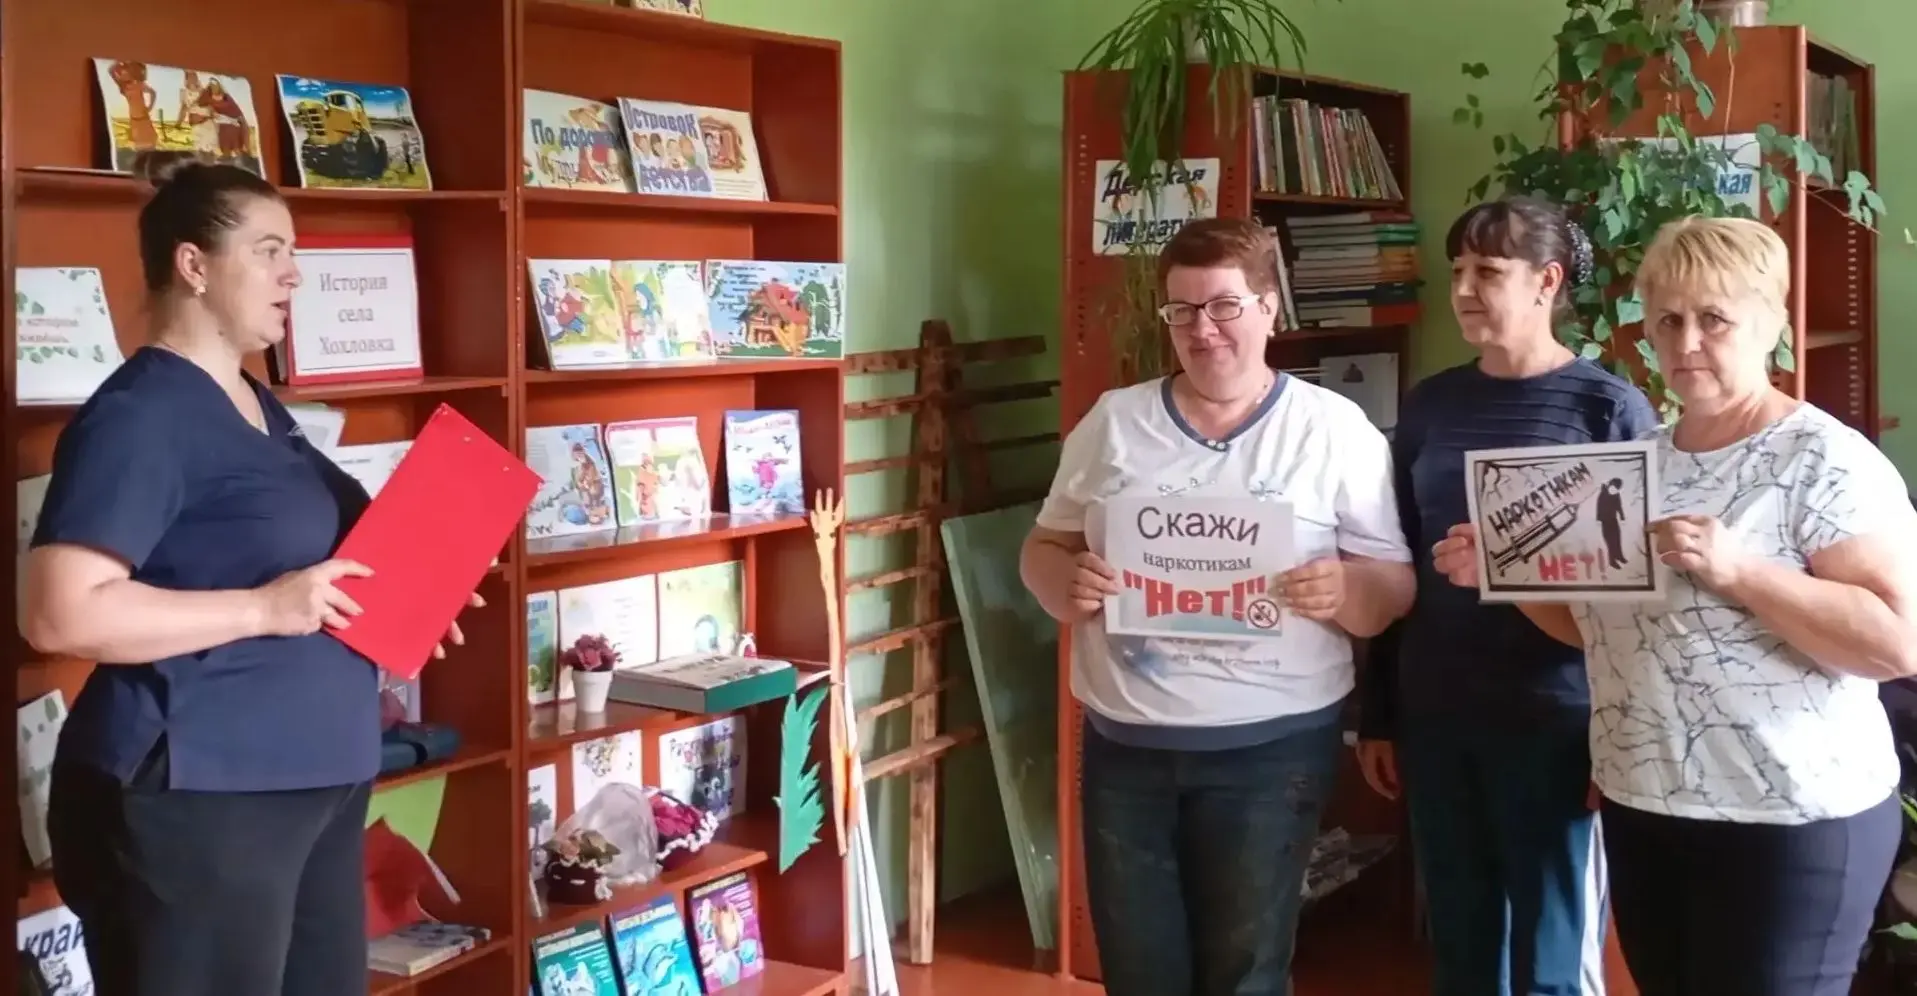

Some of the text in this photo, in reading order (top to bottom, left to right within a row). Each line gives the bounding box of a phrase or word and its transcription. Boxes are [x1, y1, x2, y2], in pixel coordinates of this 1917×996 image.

[531, 118, 555, 145] По
[623, 100, 698, 139] Островок
[319, 273, 388, 296] История
[338, 308, 374, 323] села
[319, 337, 395, 355] Хохловка
[1488, 461, 1593, 539] НАРКОТИКАМ
[1137, 506, 1260, 546] Скажи
[1143, 552, 1252, 572] наркотикам
[1537, 547, 1607, 581] НЕТ!
[1123, 568, 1266, 622] "Нет!"
